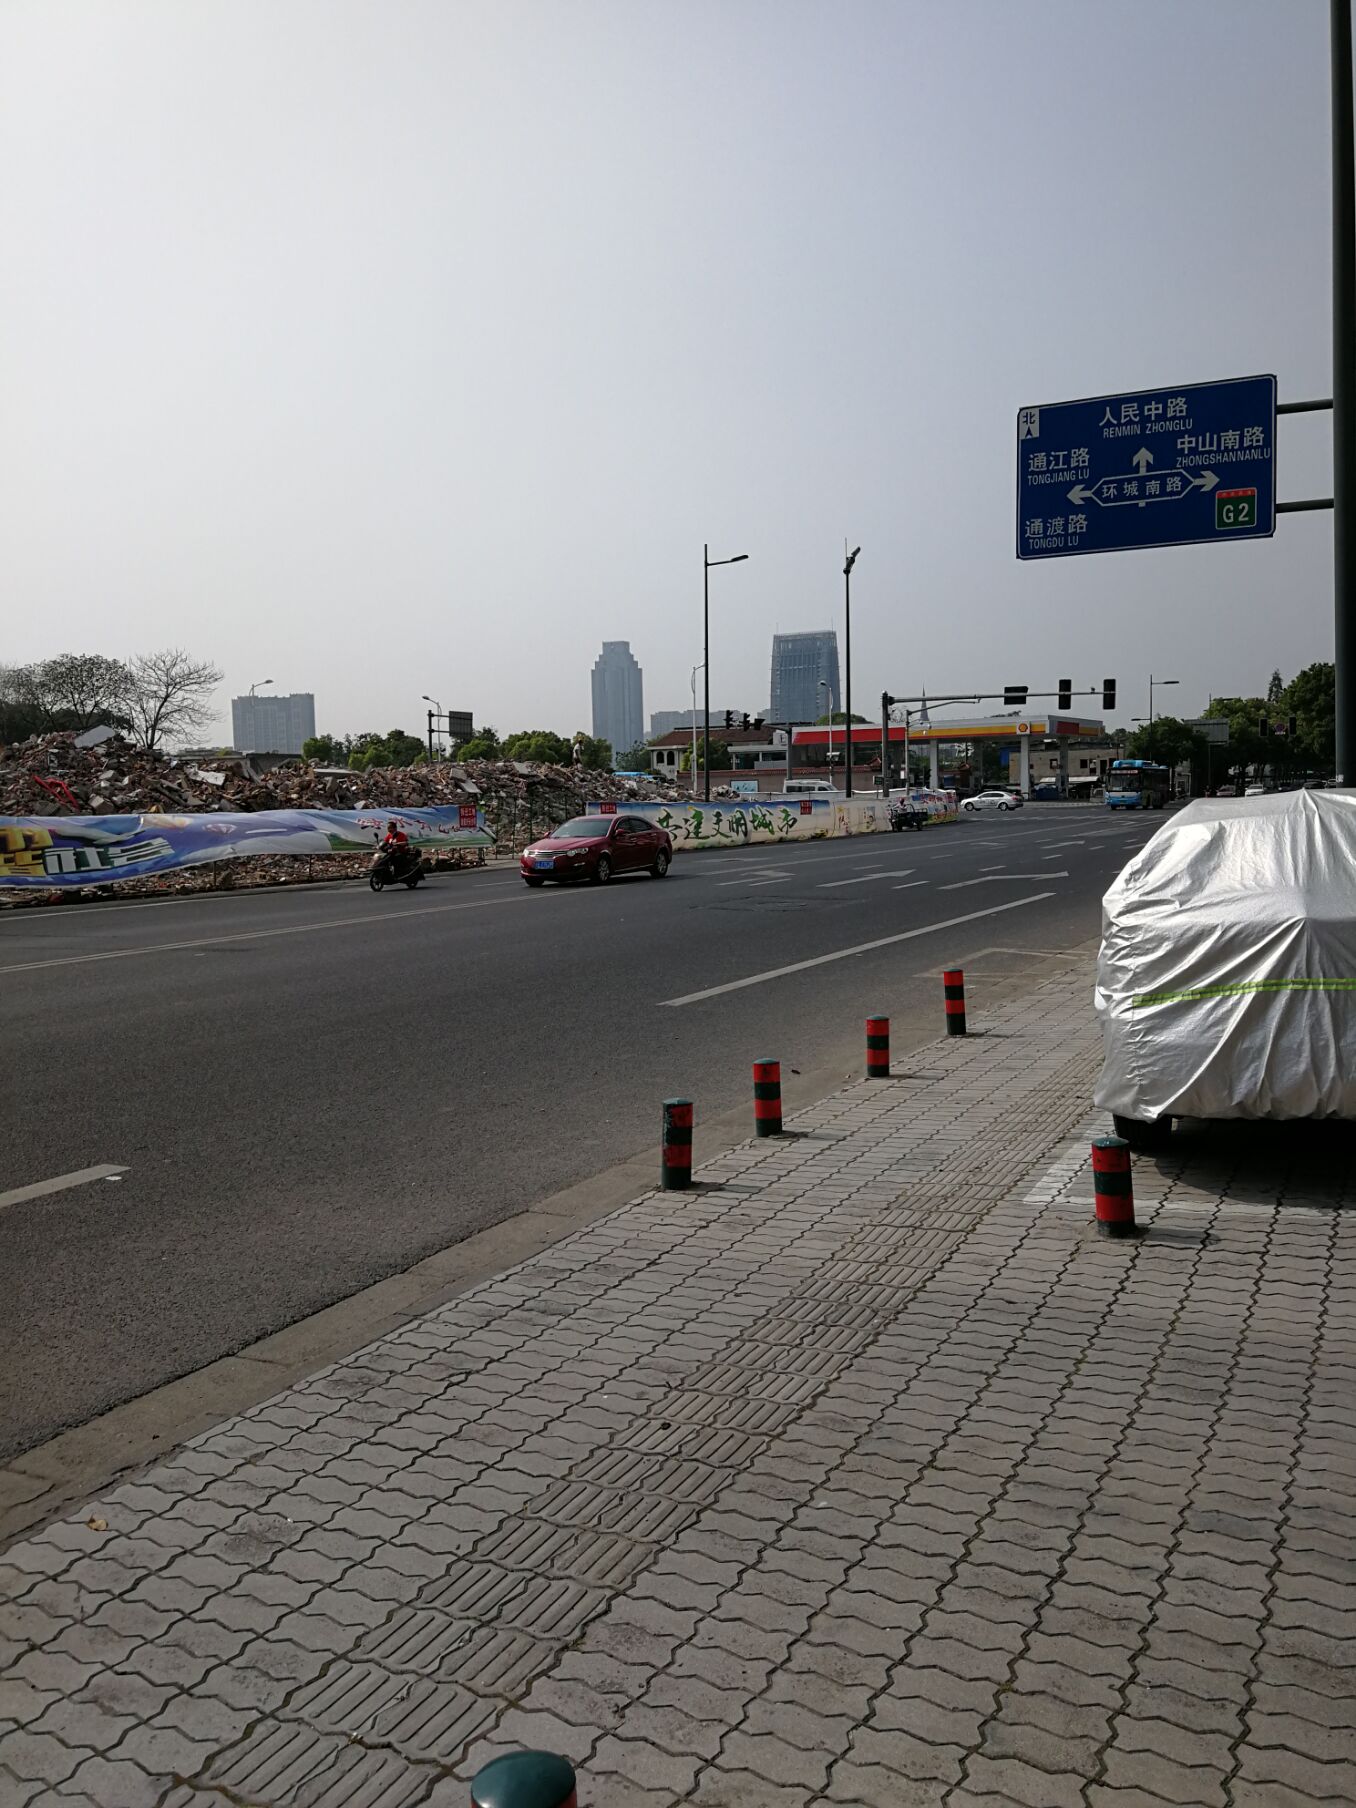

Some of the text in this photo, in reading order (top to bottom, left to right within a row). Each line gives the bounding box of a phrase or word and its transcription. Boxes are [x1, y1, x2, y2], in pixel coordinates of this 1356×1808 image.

[1022, 411, 1036, 425] 北
[1099, 396, 1188, 426] 人民中路
[1103, 418, 1193, 438] RENMIN ZHONGLU
[1176, 426, 1265, 454] 中山南路
[1028, 447, 1090, 472] 通江路
[1176, 448, 1271, 468] ZHONGSHANNANLU
[1027, 468, 1090, 486] TONGJIANG LU
[1101, 476, 1183, 499] 环城南路
[1222, 503, 1249, 523] G2
[1024, 513, 1088, 538] 通渡路
[1029, 535, 1079, 549] TONGDU LU
